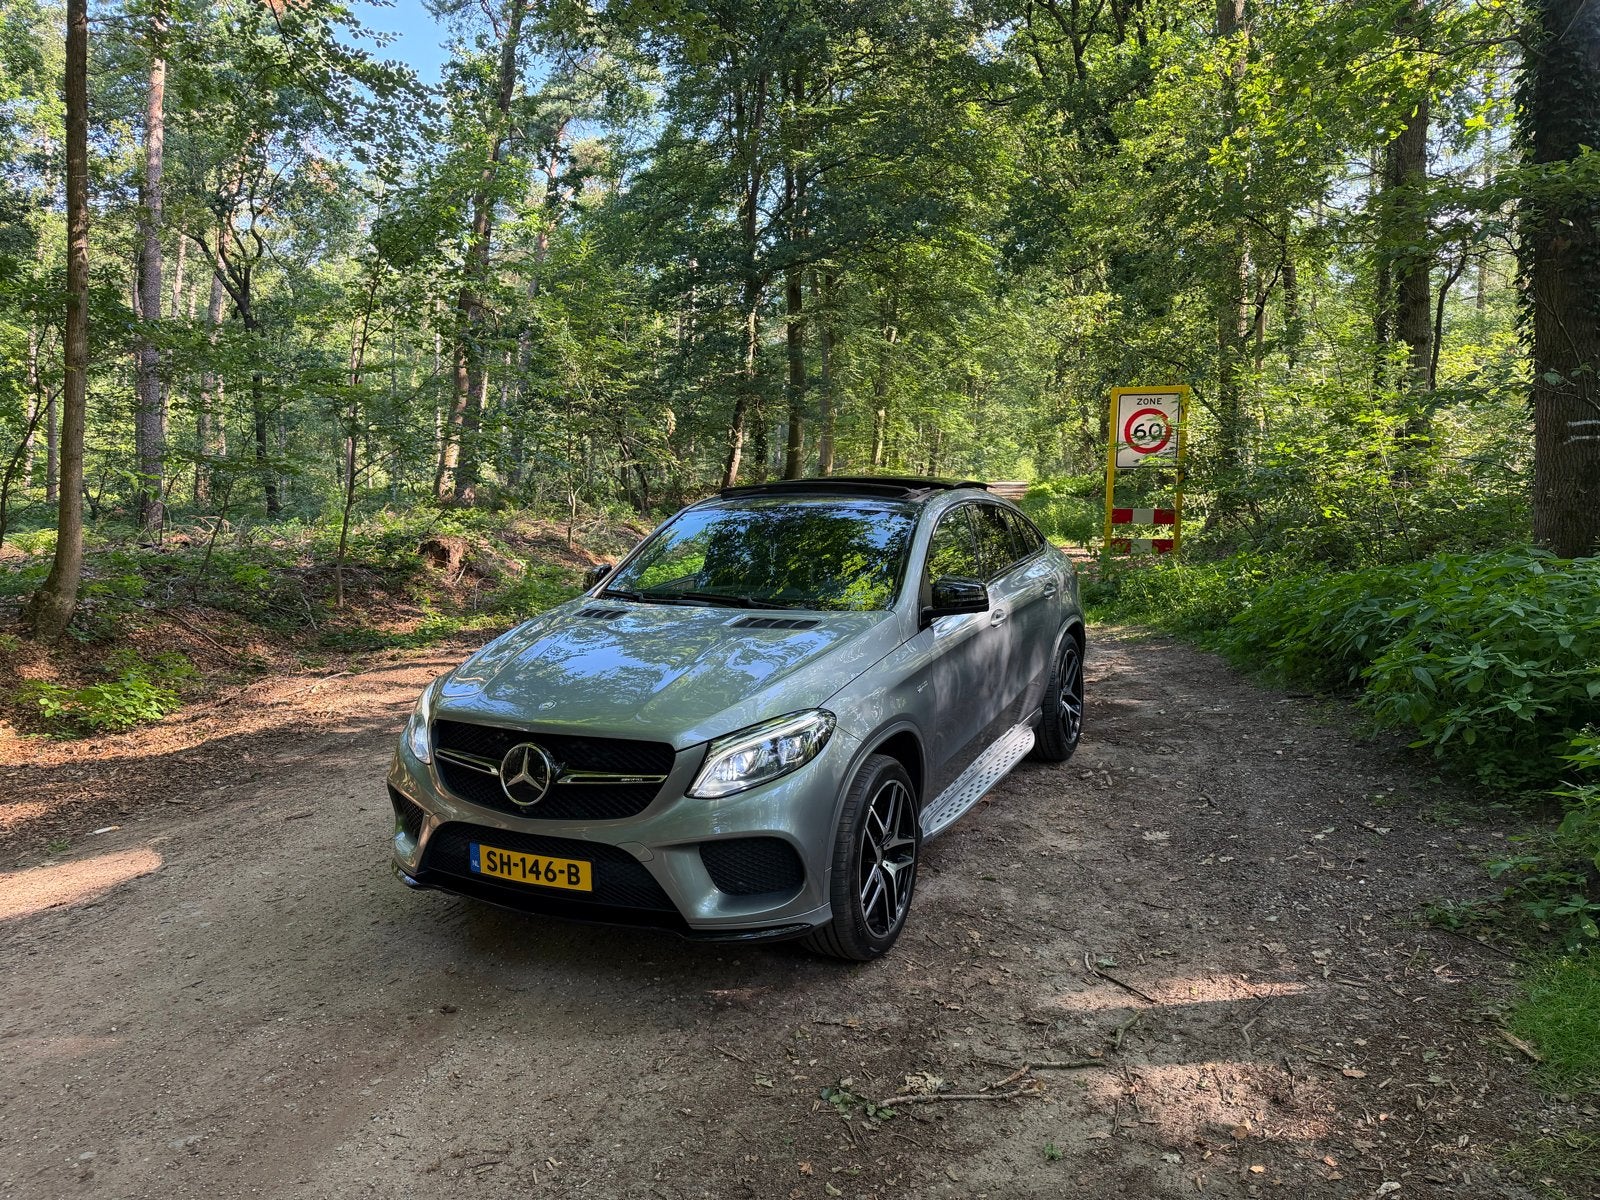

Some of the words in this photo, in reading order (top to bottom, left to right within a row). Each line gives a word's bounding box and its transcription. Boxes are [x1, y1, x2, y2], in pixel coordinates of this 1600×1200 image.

[1136, 397, 1163, 406] ZONE
[1133, 423, 1163, 440] 60
[472, 859, 480, 868] NL
[486, 850, 581, 886] SH-146-B
